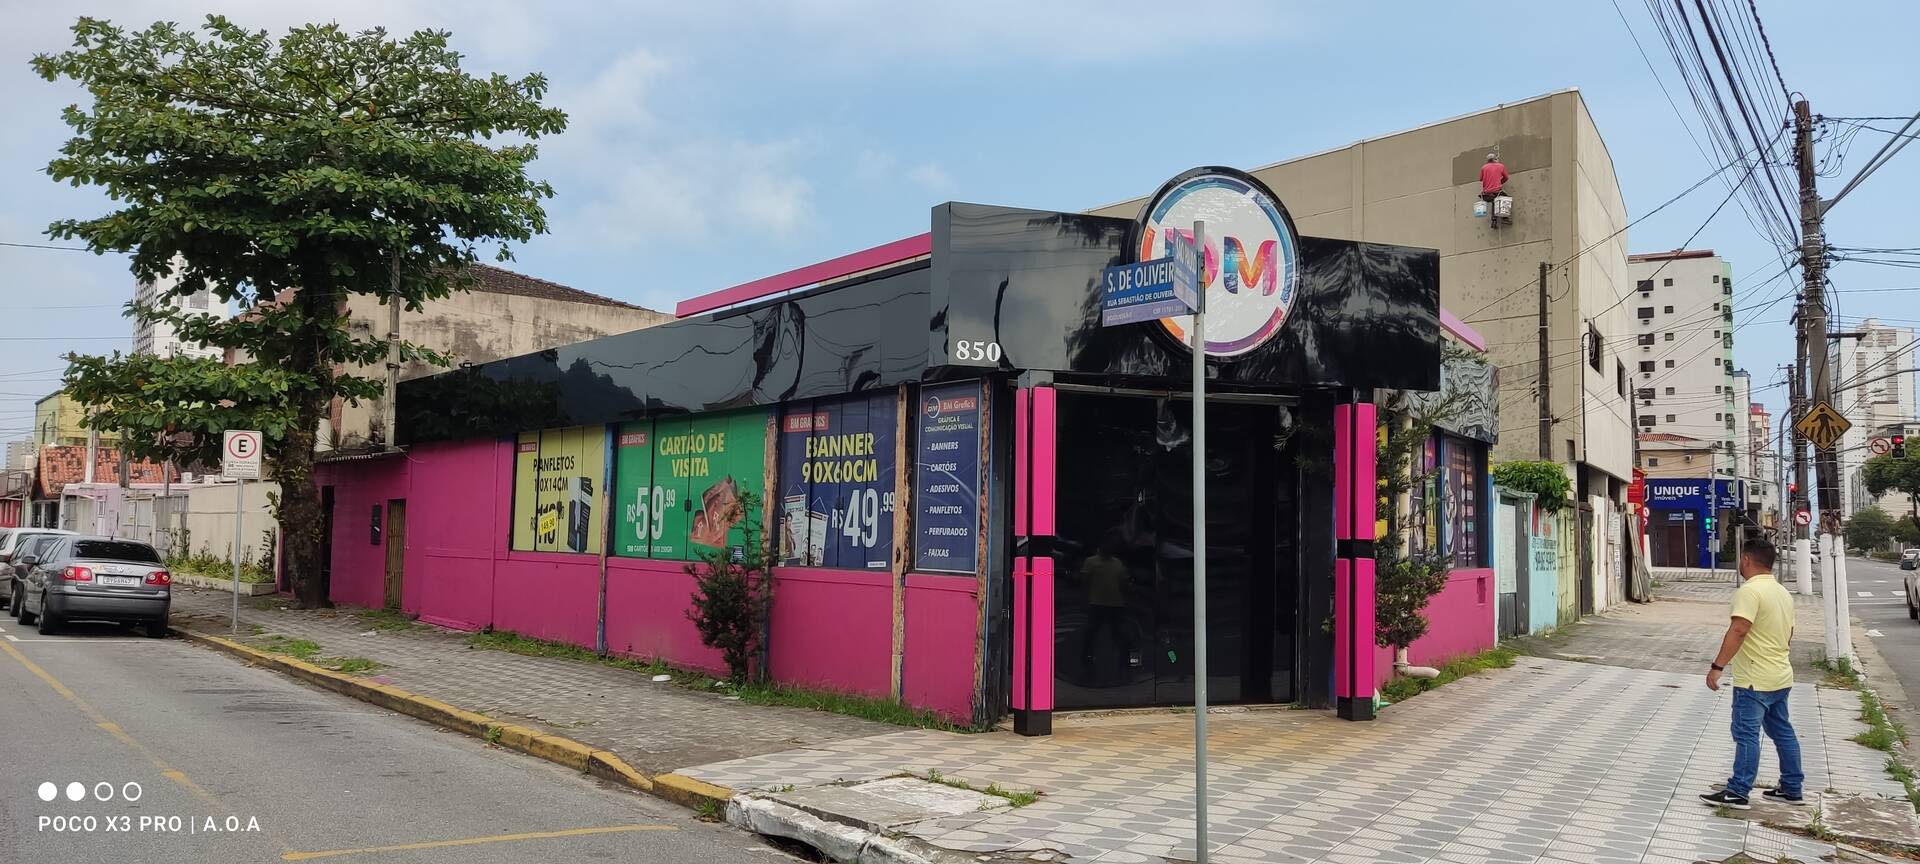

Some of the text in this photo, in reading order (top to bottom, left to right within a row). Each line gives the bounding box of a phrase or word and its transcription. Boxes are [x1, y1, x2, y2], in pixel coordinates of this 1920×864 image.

[1107, 271, 1116, 294] S.
[1119, 268, 1133, 291] DE
[1134, 260, 1175, 288] OLIVEIR
[1117, 293, 1145, 306] SEBASTIÃO
[1145, 293, 1153, 301] DE
[956, 340, 1001, 362] 850
[943, 401, 953, 410] BM
[790, 417, 800, 430] BM
[938, 416, 957, 424] GRÁFICA
[925, 424, 958, 432] COMUNICAÇÃO
[238, 439, 248, 453] E
[660, 428, 725, 457] CARTÃO DE
[805, 432, 875, 459] BANNER
[931, 441, 959, 451] BANNERS
[533, 455, 575, 473] PANFLETOS
[671, 457, 709, 478] VISITA
[930, 460, 957, 472] CARTÕES
[801, 458, 878, 484] 90X60CM
[534, 477, 569, 493] 10X14CM
[930, 484, 960, 493] ADESIVOS
[1654, 486, 1700, 498] UNIQUE
[626, 503, 636, 523] R$
[929, 505, 963, 515] PANFLETOS
[831, 508, 844, 530] R$
[928, 527, 968, 536] PERFURADOS
[928, 548, 950, 558] FAIXAS
